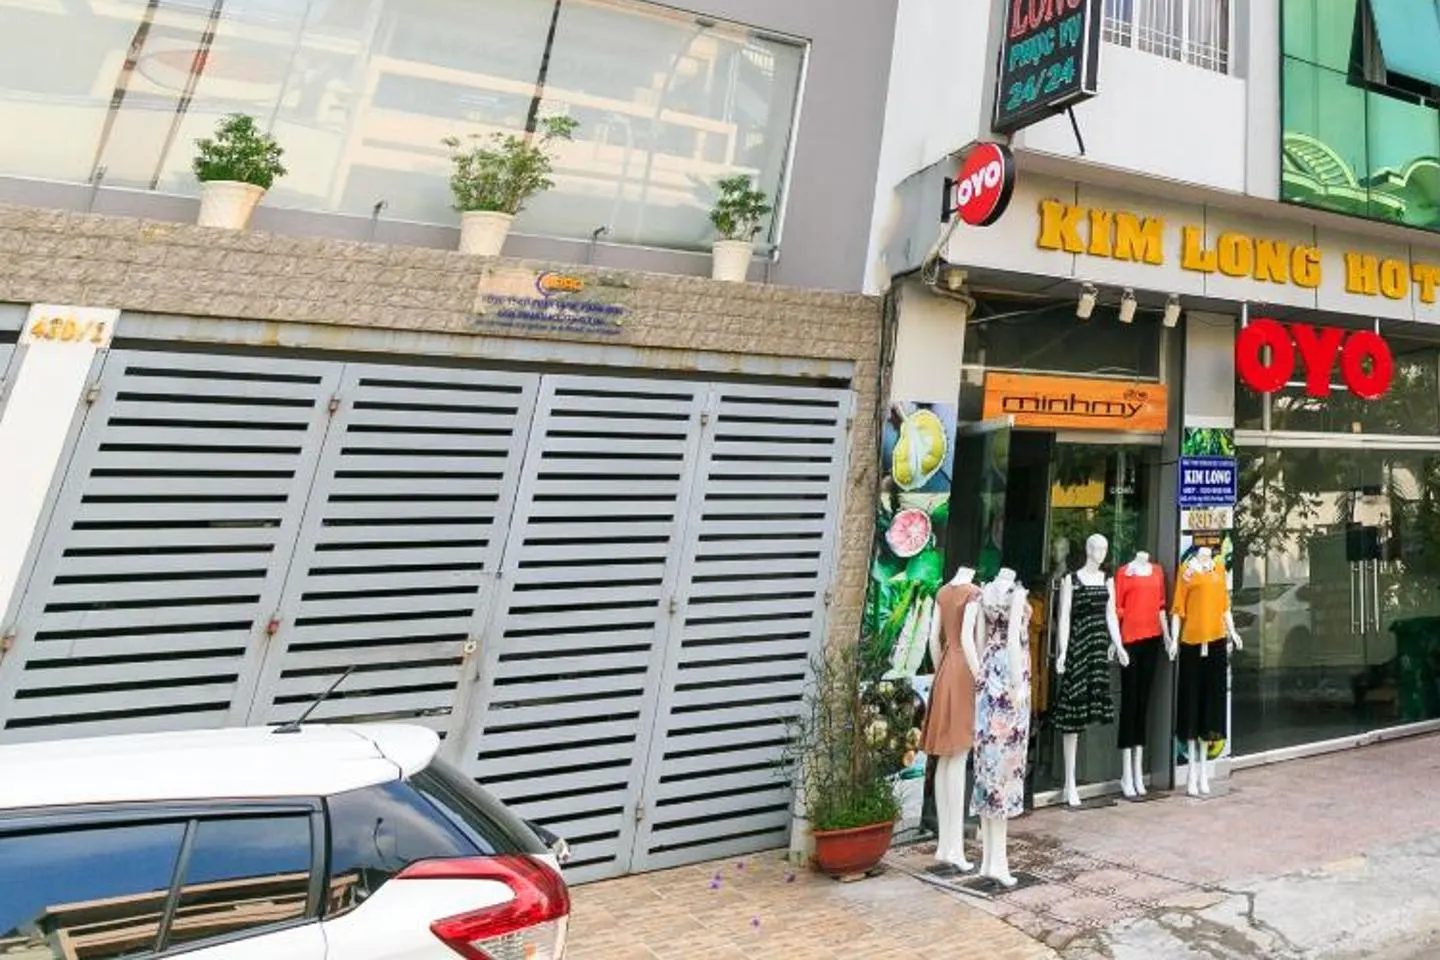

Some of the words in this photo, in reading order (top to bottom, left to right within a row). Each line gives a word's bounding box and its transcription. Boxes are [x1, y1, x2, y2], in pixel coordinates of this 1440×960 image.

[1006, 56, 1076, 111] 24/24
[957, 160, 1001, 207] OYO
[1037, 198, 1165, 266] KIM
[1180, 224, 1323, 289] LONG
[1235, 317, 1395, 400] OYO
[1184, 469, 1203, 485] KIM
[1205, 470, 1231, 485] LONG
